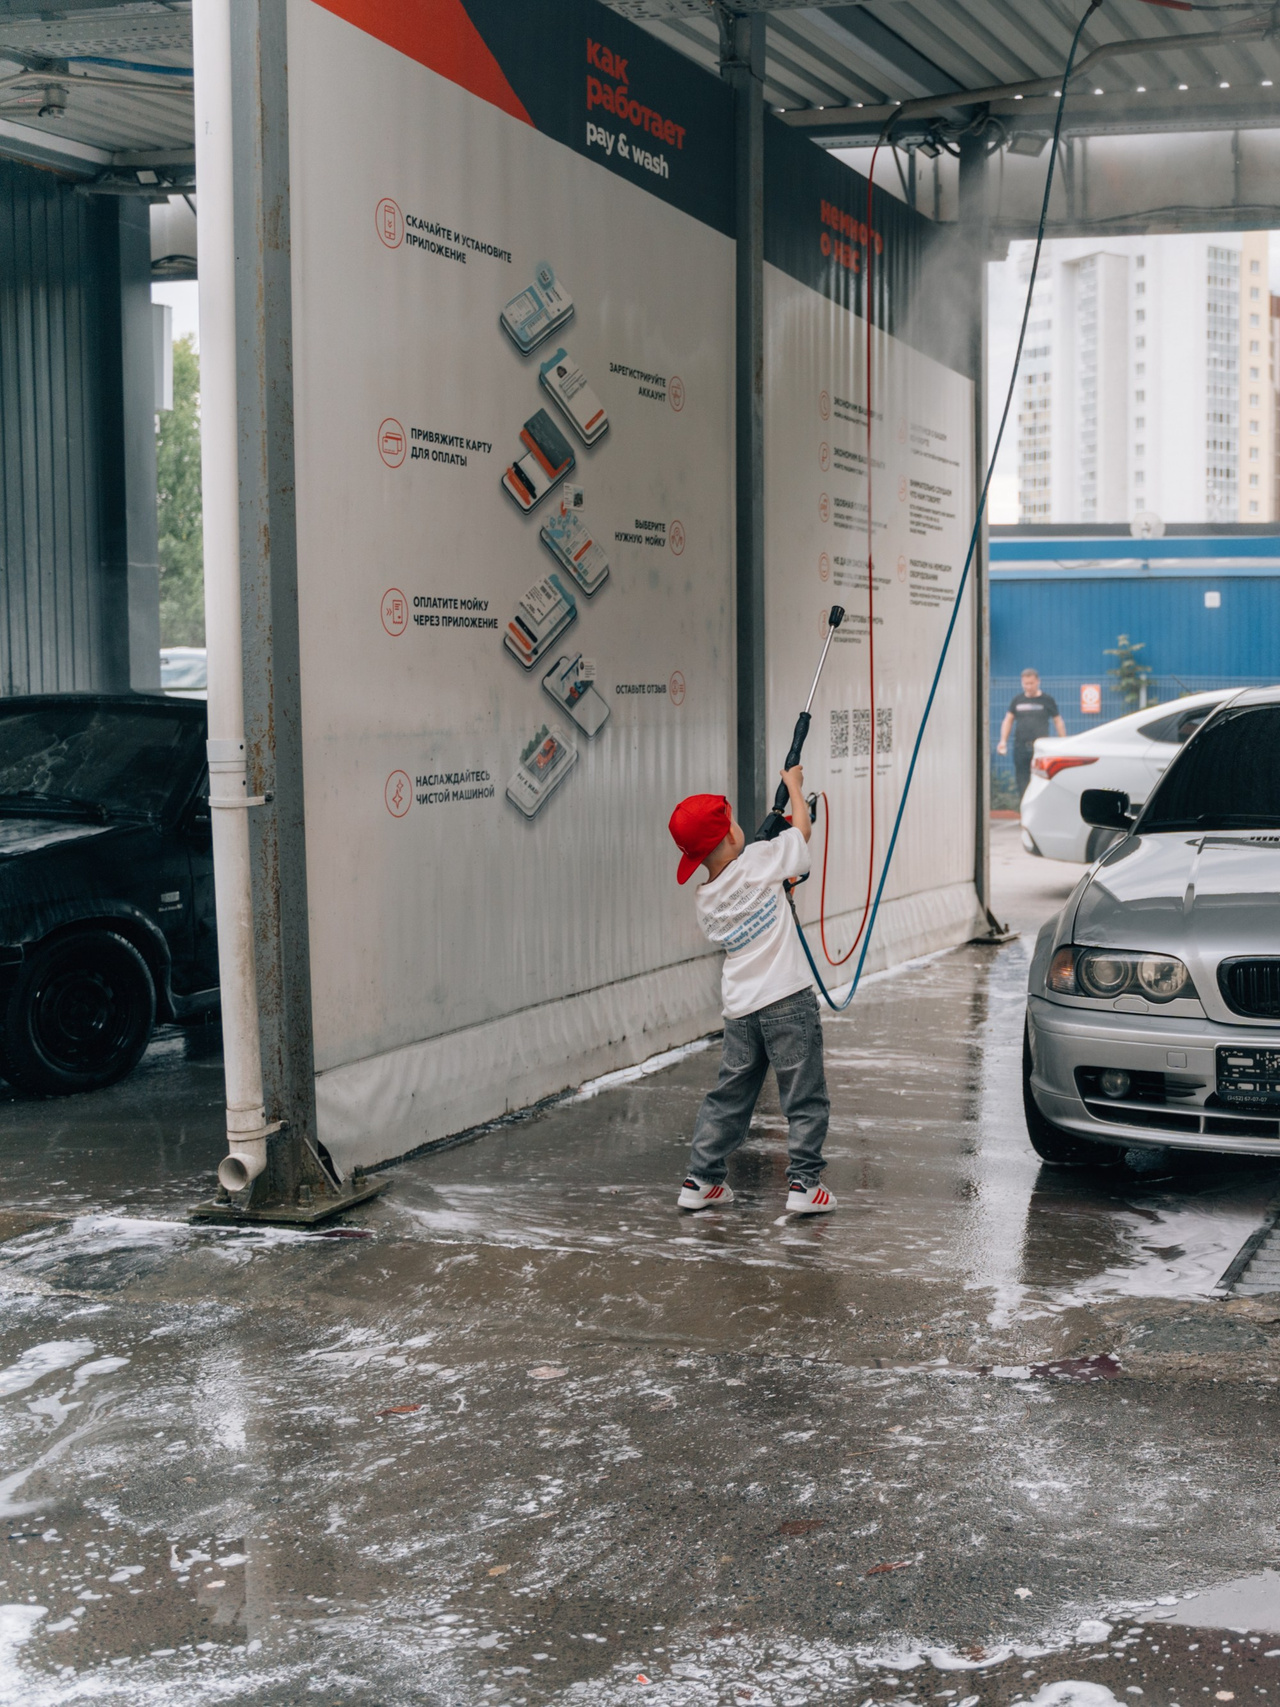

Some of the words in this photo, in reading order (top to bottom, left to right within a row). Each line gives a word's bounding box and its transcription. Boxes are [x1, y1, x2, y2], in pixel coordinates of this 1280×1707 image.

[587, 37, 629, 85] как
[587, 74, 686, 150] работает
[587, 121, 615, 156] pay
[617, 133, 630, 159] &
[632, 145, 669, 179] wash
[405, 214, 452, 242] СКАЧАЙТЕ
[453, 231, 460, 244] И
[461, 234, 512, 264] УСТАНОВИТЕ
[405, 232, 467, 264] ПРИЛОЖЕНИЕ
[609, 362, 666, 388] ЗАРЕГИСТРИРУЙТЕ
[638, 386, 666, 402] АККАУНТ
[410, 427, 464, 449] ПРИВЯЖИТЕ
[465, 438, 492, 454] КАРТУ
[411, 446, 430, 460] ДЛЯ
[431, 449, 468, 467] ОПЛАТЫ
[635, 519, 666, 533] ВЫБЕРИТЕ
[614, 531, 643, 544] НУЖНУЮ
[645, 535, 666, 547] МОЙКУ
[413, 596, 458, 610] ОПЛАТИТЕ
[460, 597, 489, 612] МОЙКУ
[413, 614, 440, 627] ЧЕРЕЗ
[442, 616, 499, 629] ПРИЛОЖЕНИЕ
[615, 684, 646, 695] ОСТАВЬТЕ
[647, 684, 667, 694] ОТЗЫВ
[415, 769, 490, 787] НАСЛАЖДАЙТЕСЬ
[416, 789, 450, 805] ЧИСТОЙ
[452, 784, 495, 802] МАШИНОЙ
